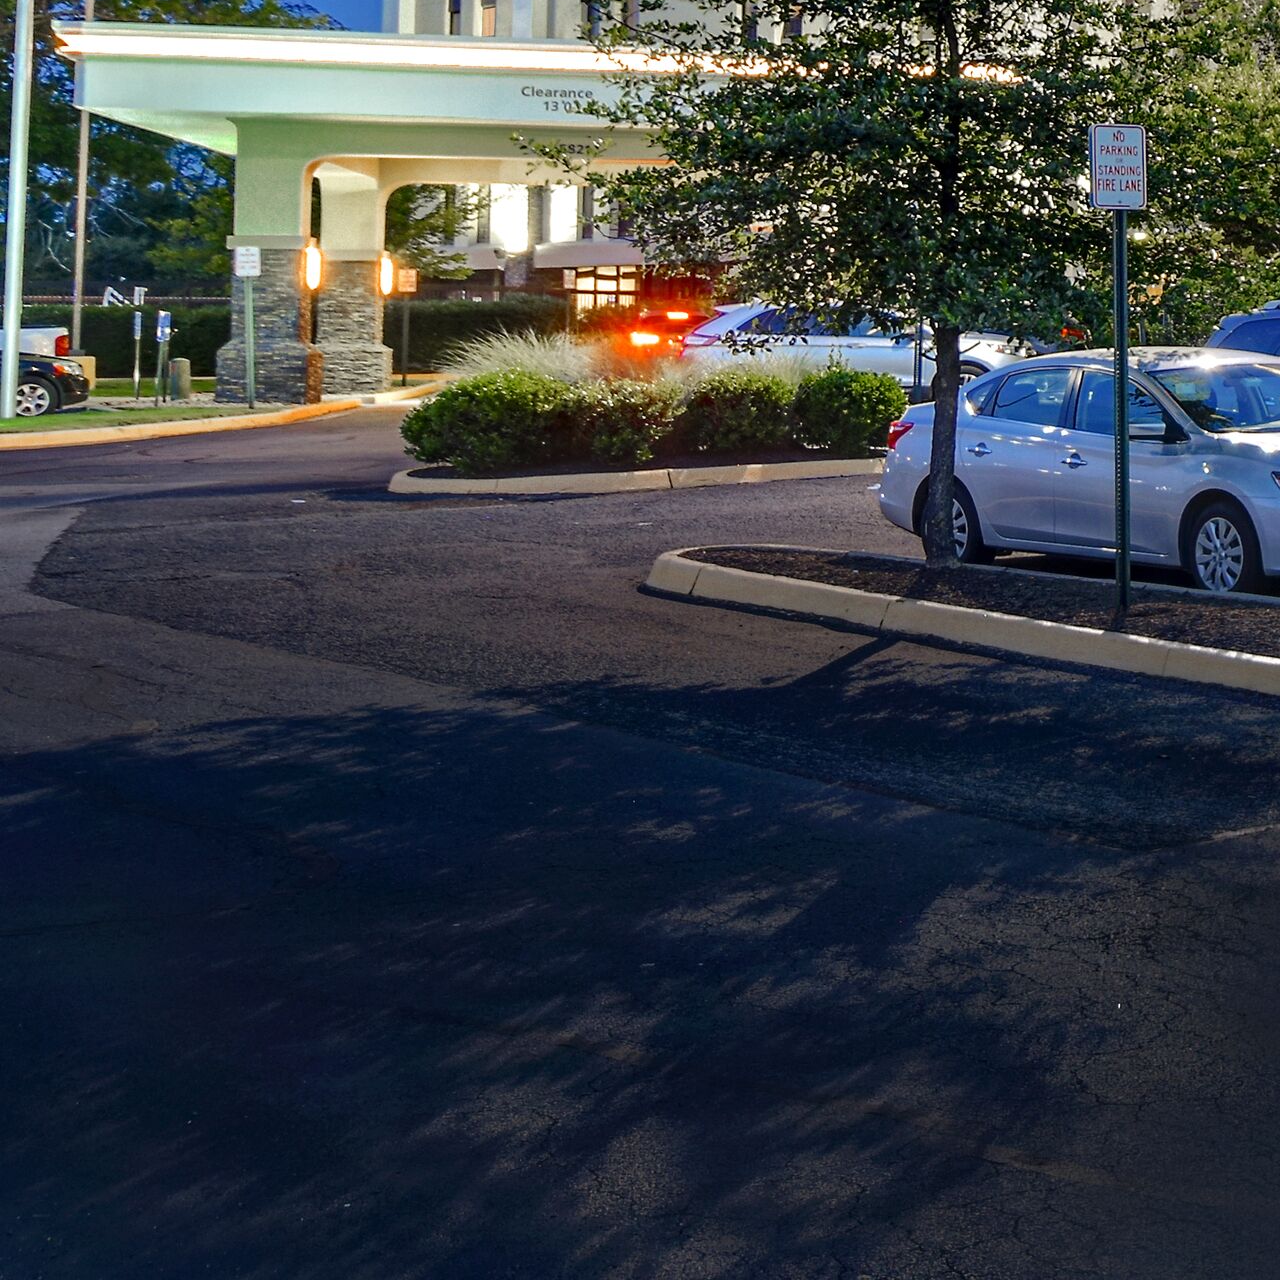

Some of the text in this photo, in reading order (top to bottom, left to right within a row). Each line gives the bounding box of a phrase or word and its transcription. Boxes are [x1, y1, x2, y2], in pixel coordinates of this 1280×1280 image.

[521, 86, 593, 98] Clearance
[1113, 130, 1125, 142] NO
[1100, 145, 1138, 156] PARKING
[1098, 165, 1142, 176] STANDING
[1097, 179, 1142, 192] FIRE LANE
